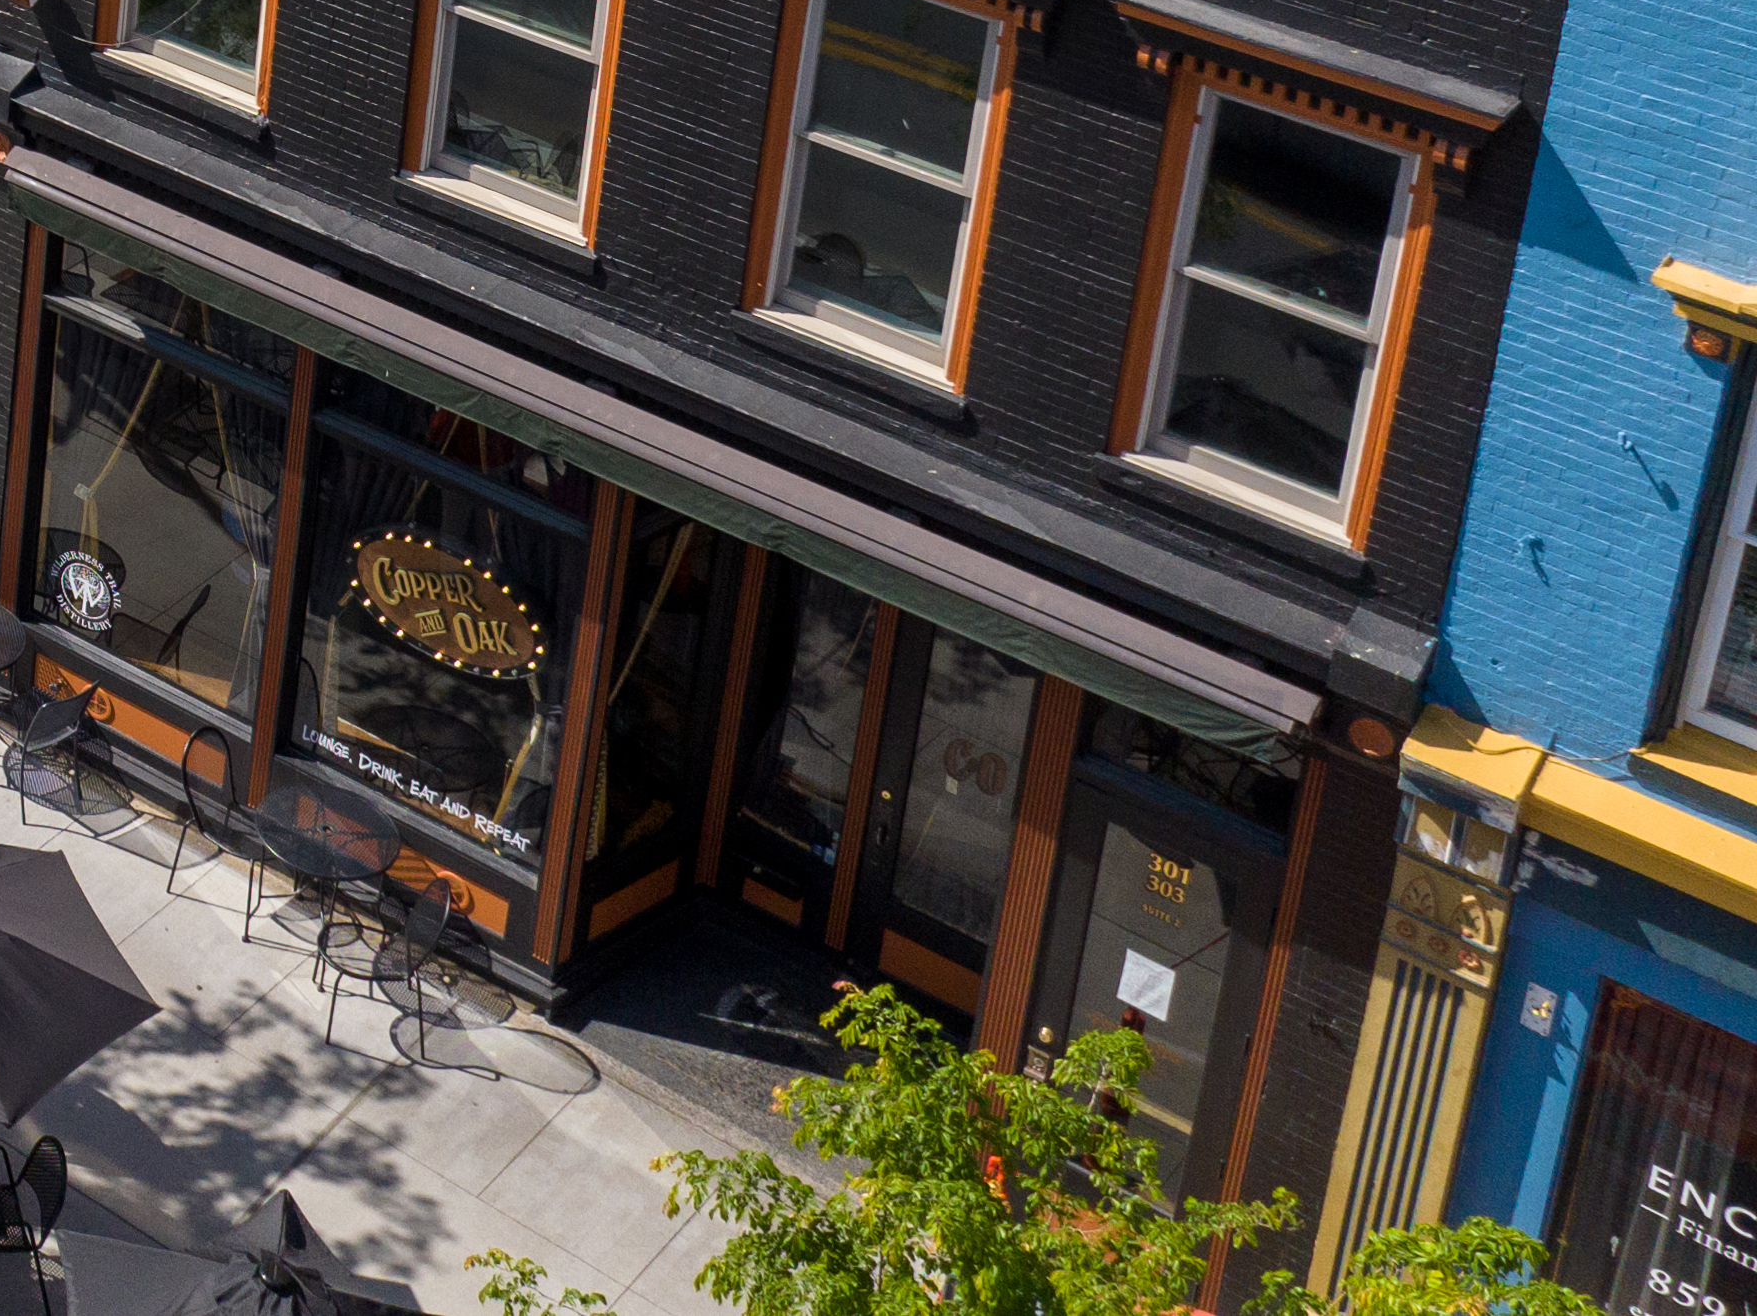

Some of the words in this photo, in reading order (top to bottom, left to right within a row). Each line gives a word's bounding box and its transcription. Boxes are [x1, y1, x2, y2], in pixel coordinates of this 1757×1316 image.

[51, 550, 104, 577] WILDERNESS
[105, 572, 122, 609] TRAIL
[372, 557, 483, 613] COPPER
[55, 593, 113, 631] DISTILLERY
[419, 614, 445, 634] AND
[453, 612, 519, 656] OAK
[409, 778, 438, 805] EAT
[440, 796, 471, 820] AND
[473, 813, 532, 853] REPEAT
[1146, 874, 1185, 903] 303
[1147, 852, 1191, 885] 301
[1648, 1268, 1726, 1316] 859
